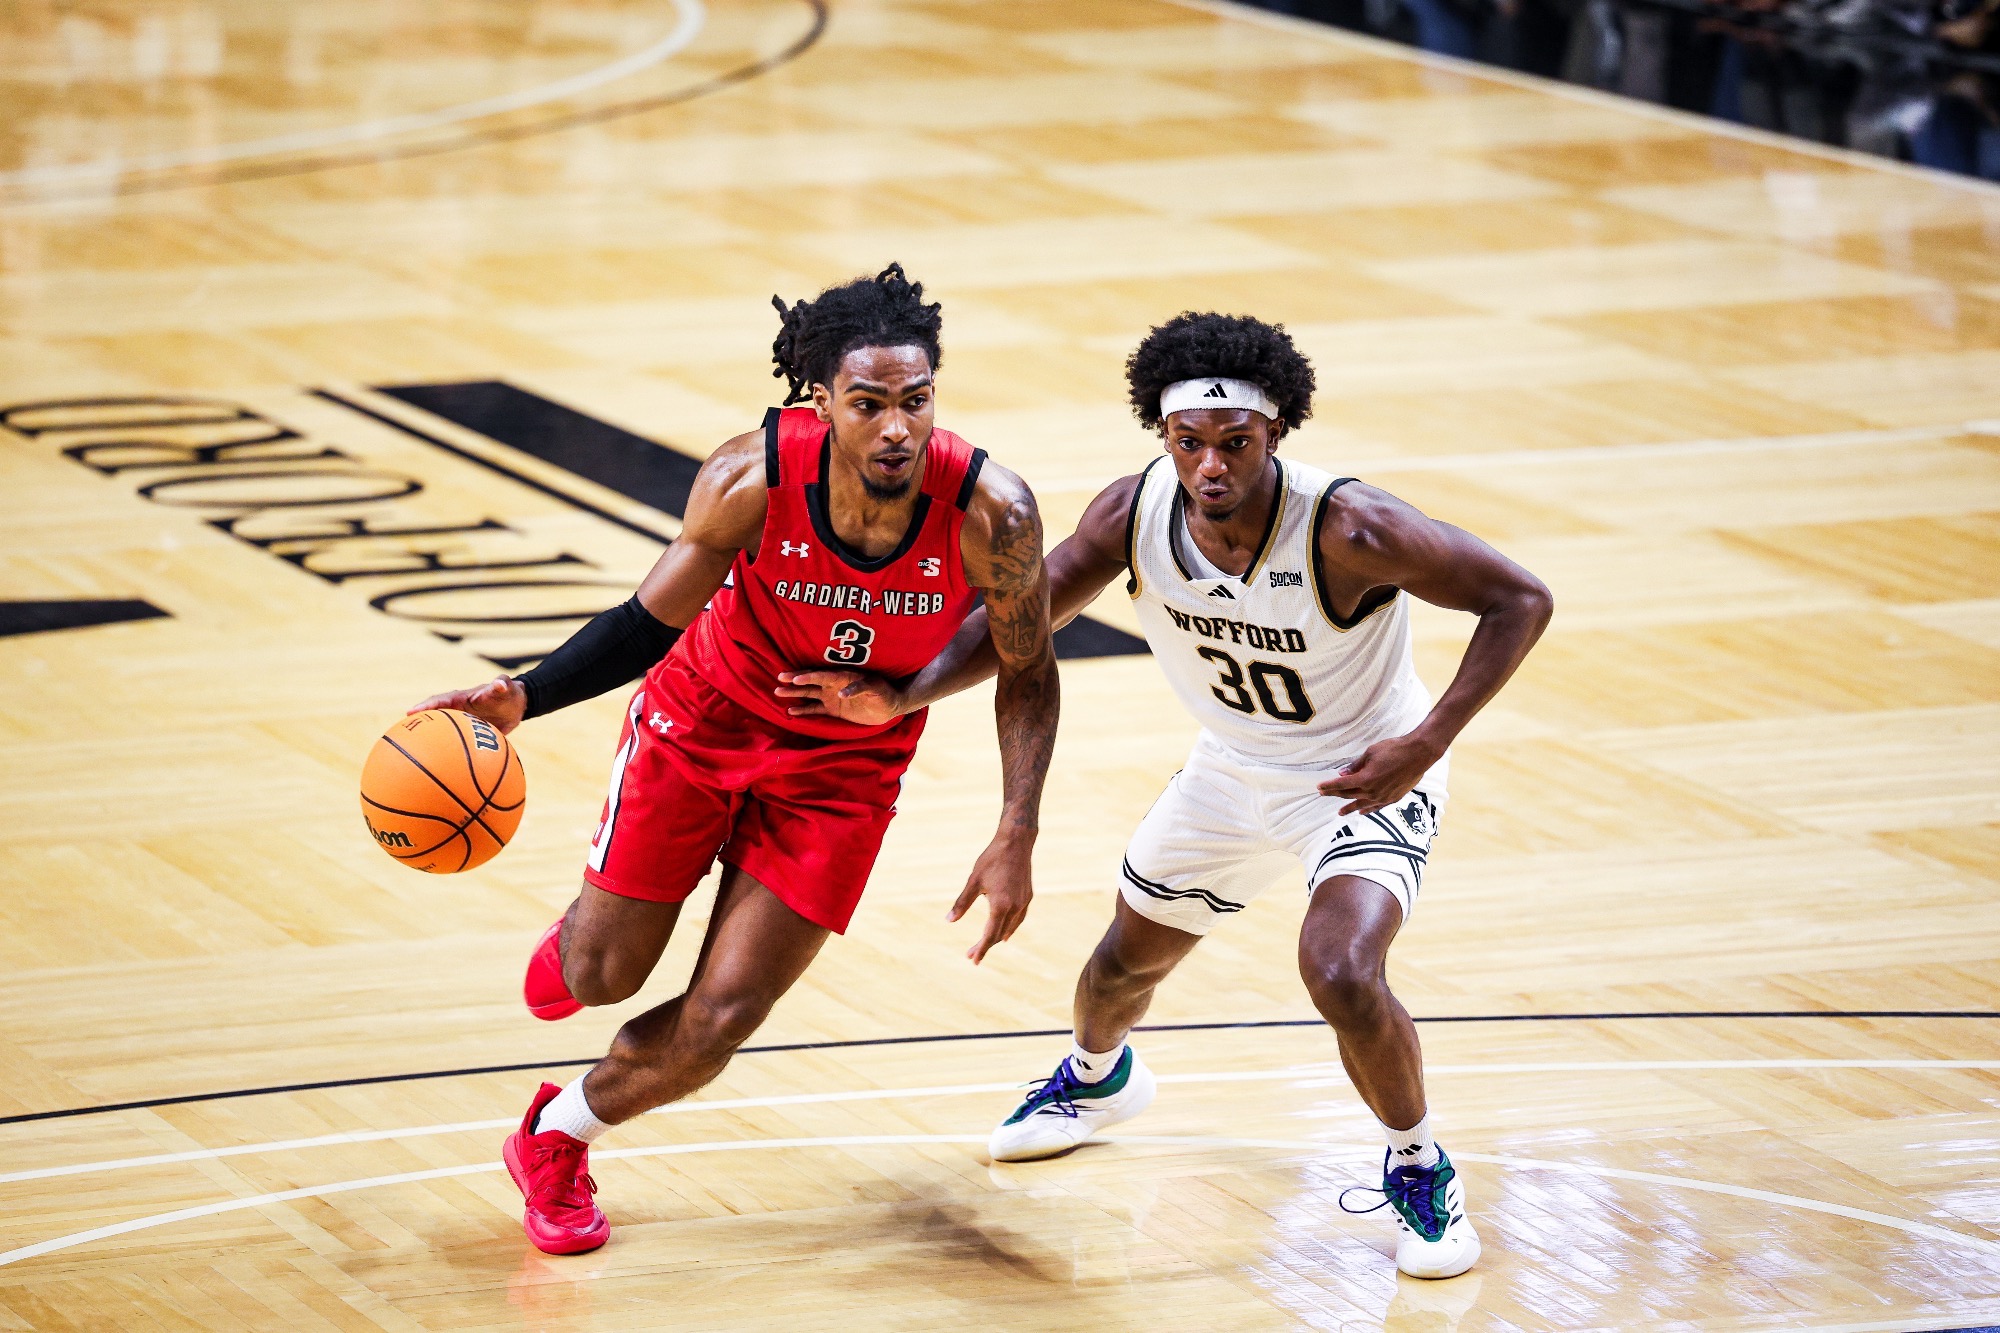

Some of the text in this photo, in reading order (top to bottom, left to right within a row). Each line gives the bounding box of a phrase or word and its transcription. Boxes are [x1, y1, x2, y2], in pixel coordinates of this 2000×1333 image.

[0, 396, 655, 669] OFFORD
[775, 580, 944, 616] GARDNER-WEBB
[823, 619, 876, 665] 3
[1163, 603, 1308, 653] WOFFORD
[1195, 644, 1317, 725] 30
